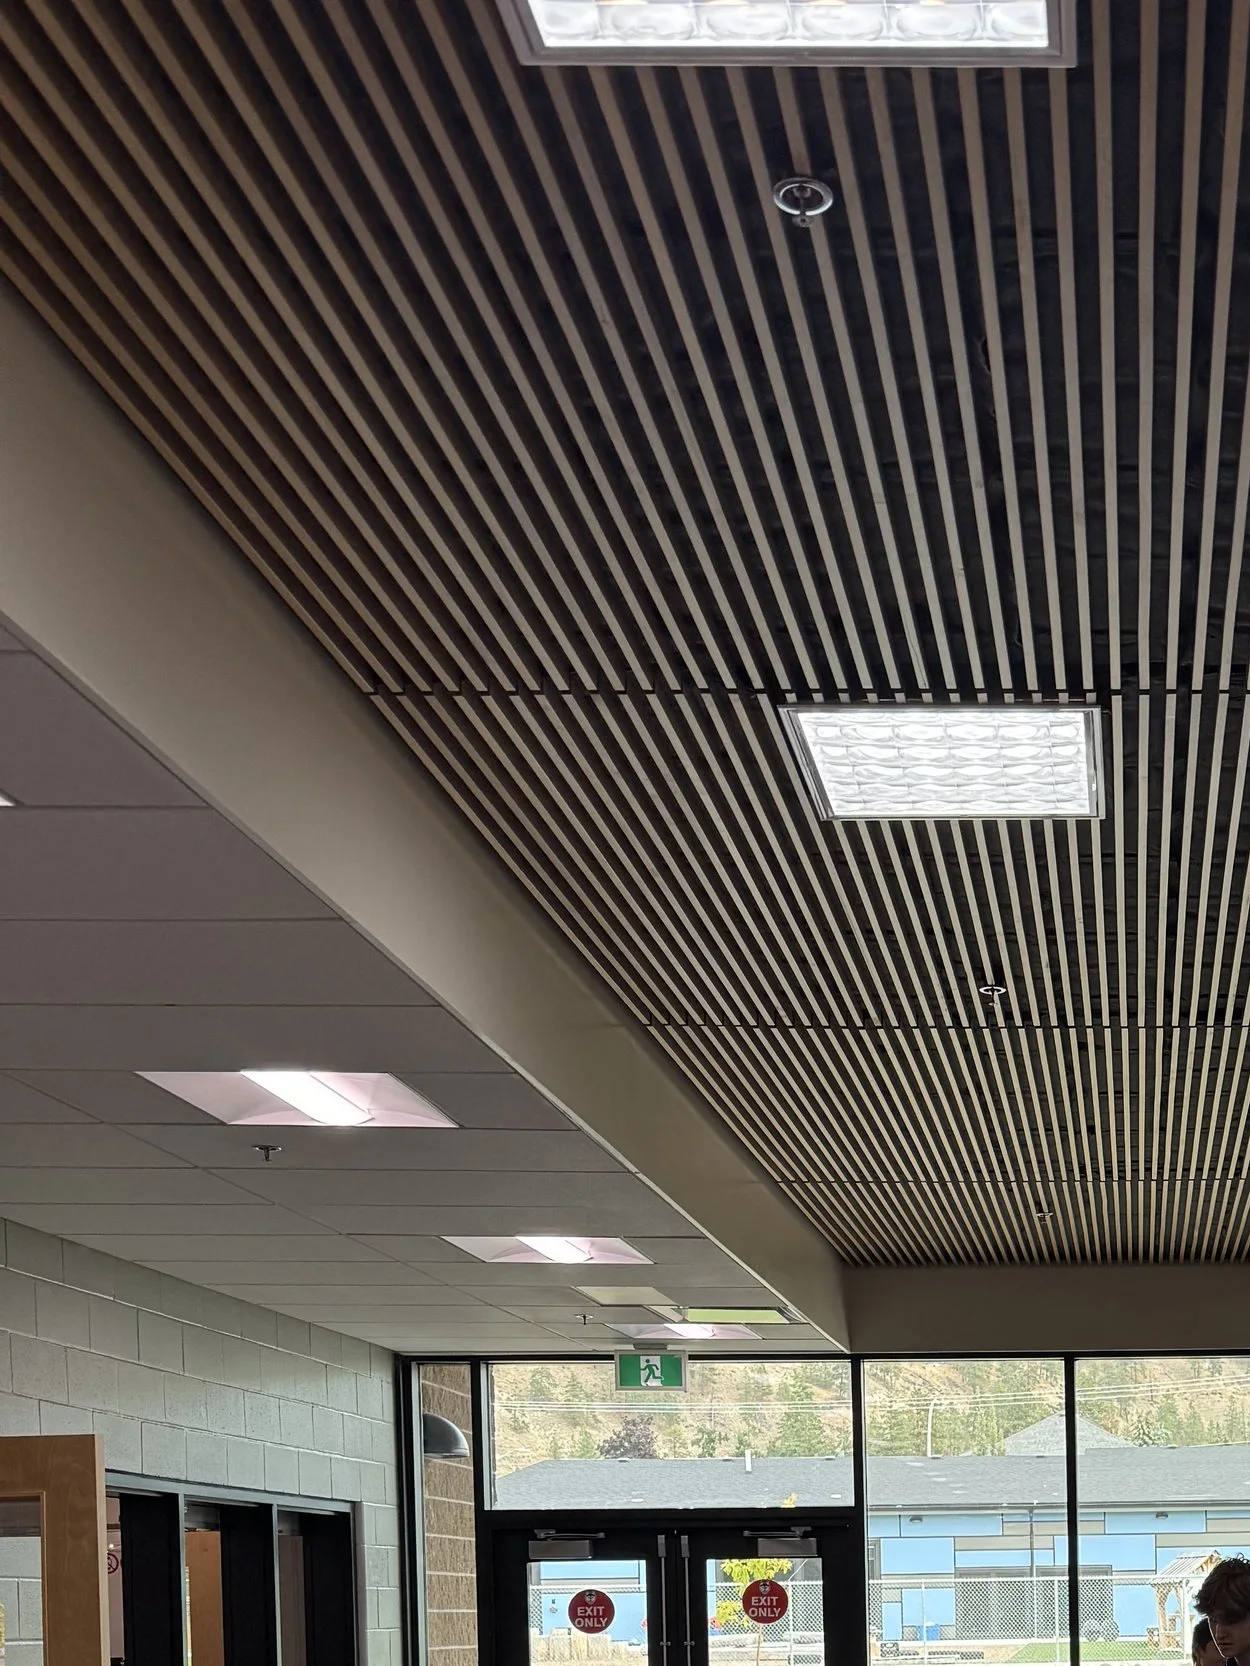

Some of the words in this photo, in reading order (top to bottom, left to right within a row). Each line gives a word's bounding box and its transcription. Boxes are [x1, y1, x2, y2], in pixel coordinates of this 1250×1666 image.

[751, 1596, 779, 1606] EXIT
[577, 1606, 605, 1617] EXIT
[748, 1607, 781, 1618] ONLY
[574, 1617, 608, 1628] ONLY
